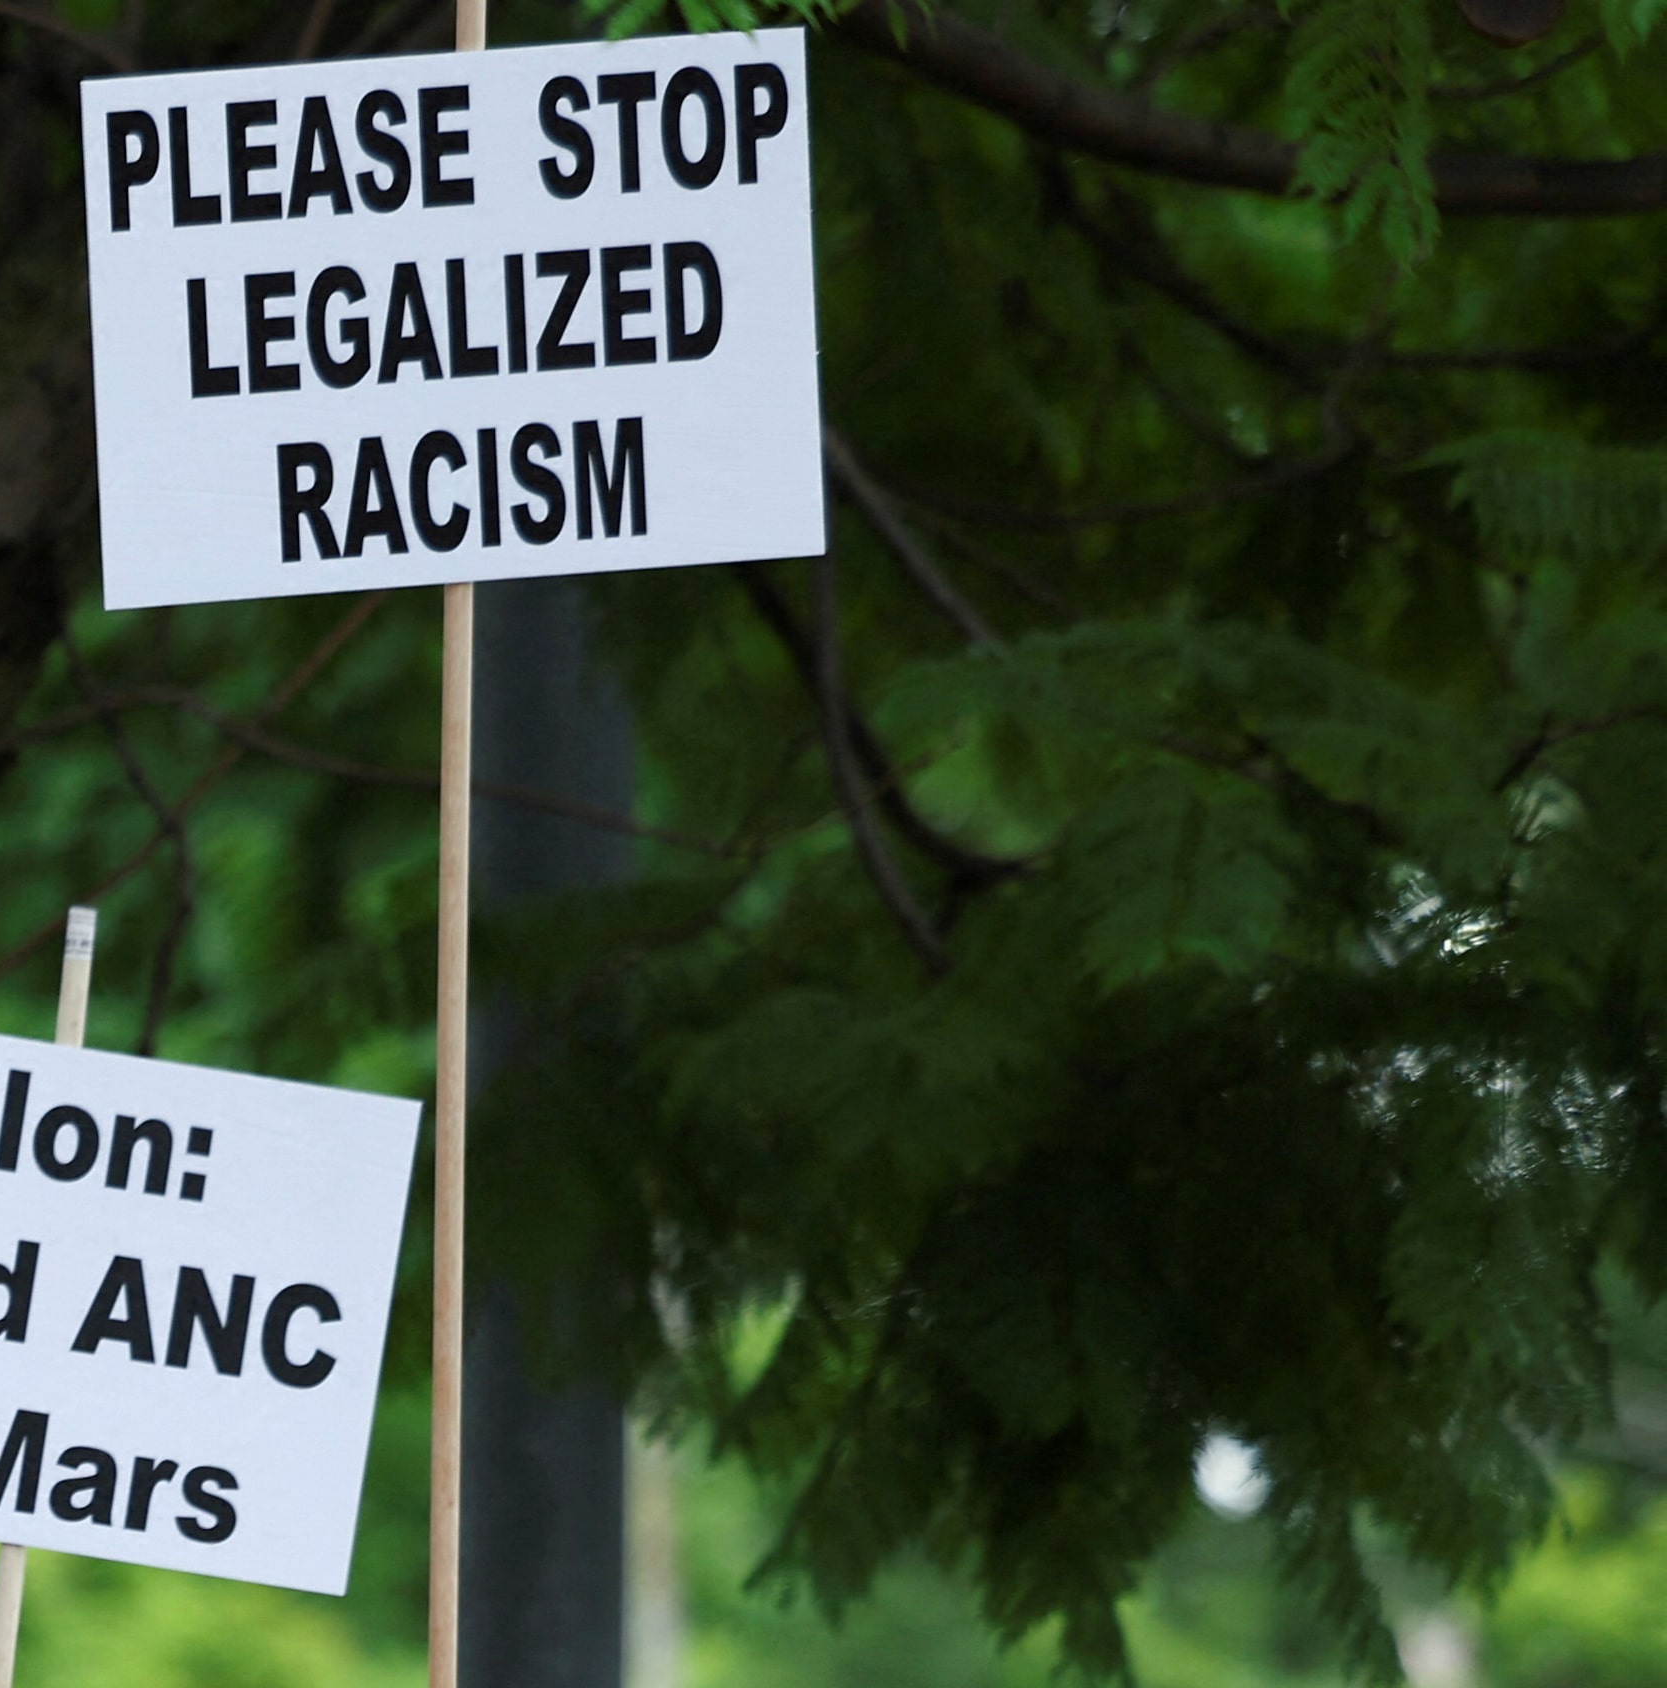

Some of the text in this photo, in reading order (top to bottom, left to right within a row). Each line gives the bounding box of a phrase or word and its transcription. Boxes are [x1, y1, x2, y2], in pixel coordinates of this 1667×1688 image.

[105, 61, 792, 233] PLEASE STOP
[185, 239, 724, 400] LEGALIZED
[275, 415, 649, 564] RACISM
[70, 1254, 343, 1390] ANC
